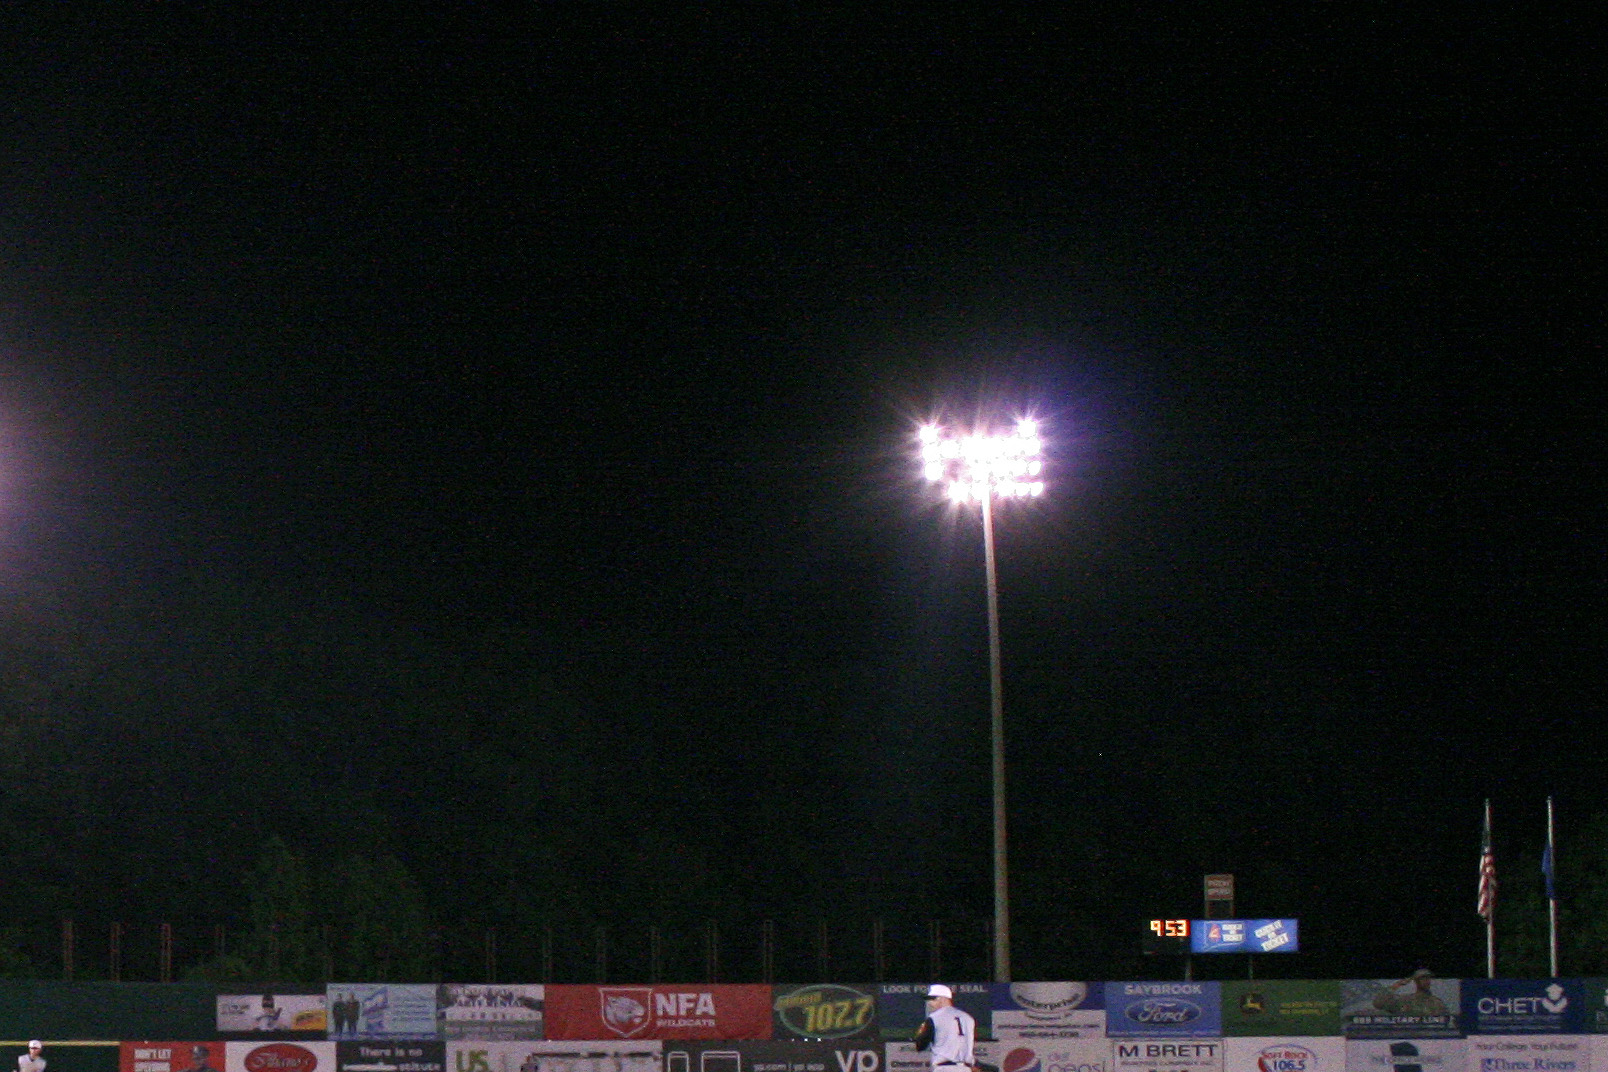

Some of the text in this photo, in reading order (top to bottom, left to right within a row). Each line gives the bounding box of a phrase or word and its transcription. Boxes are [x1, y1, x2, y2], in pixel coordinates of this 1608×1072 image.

[883, 984, 911, 994] LOOK
[1124, 984, 1203, 995] SAYBROOK
[654, 992, 717, 1016] NFA
[1477, 997, 1542, 1014] CHET
[1137, 1001, 1188, 1023] Ford
[655, 1018, 716, 1027] WILDCATS
[953, 1016, 965, 1037] 1
[1118, 1044, 1218, 1057] M BRETT
[1494, 1058, 1577, 1070] Three Rivers
